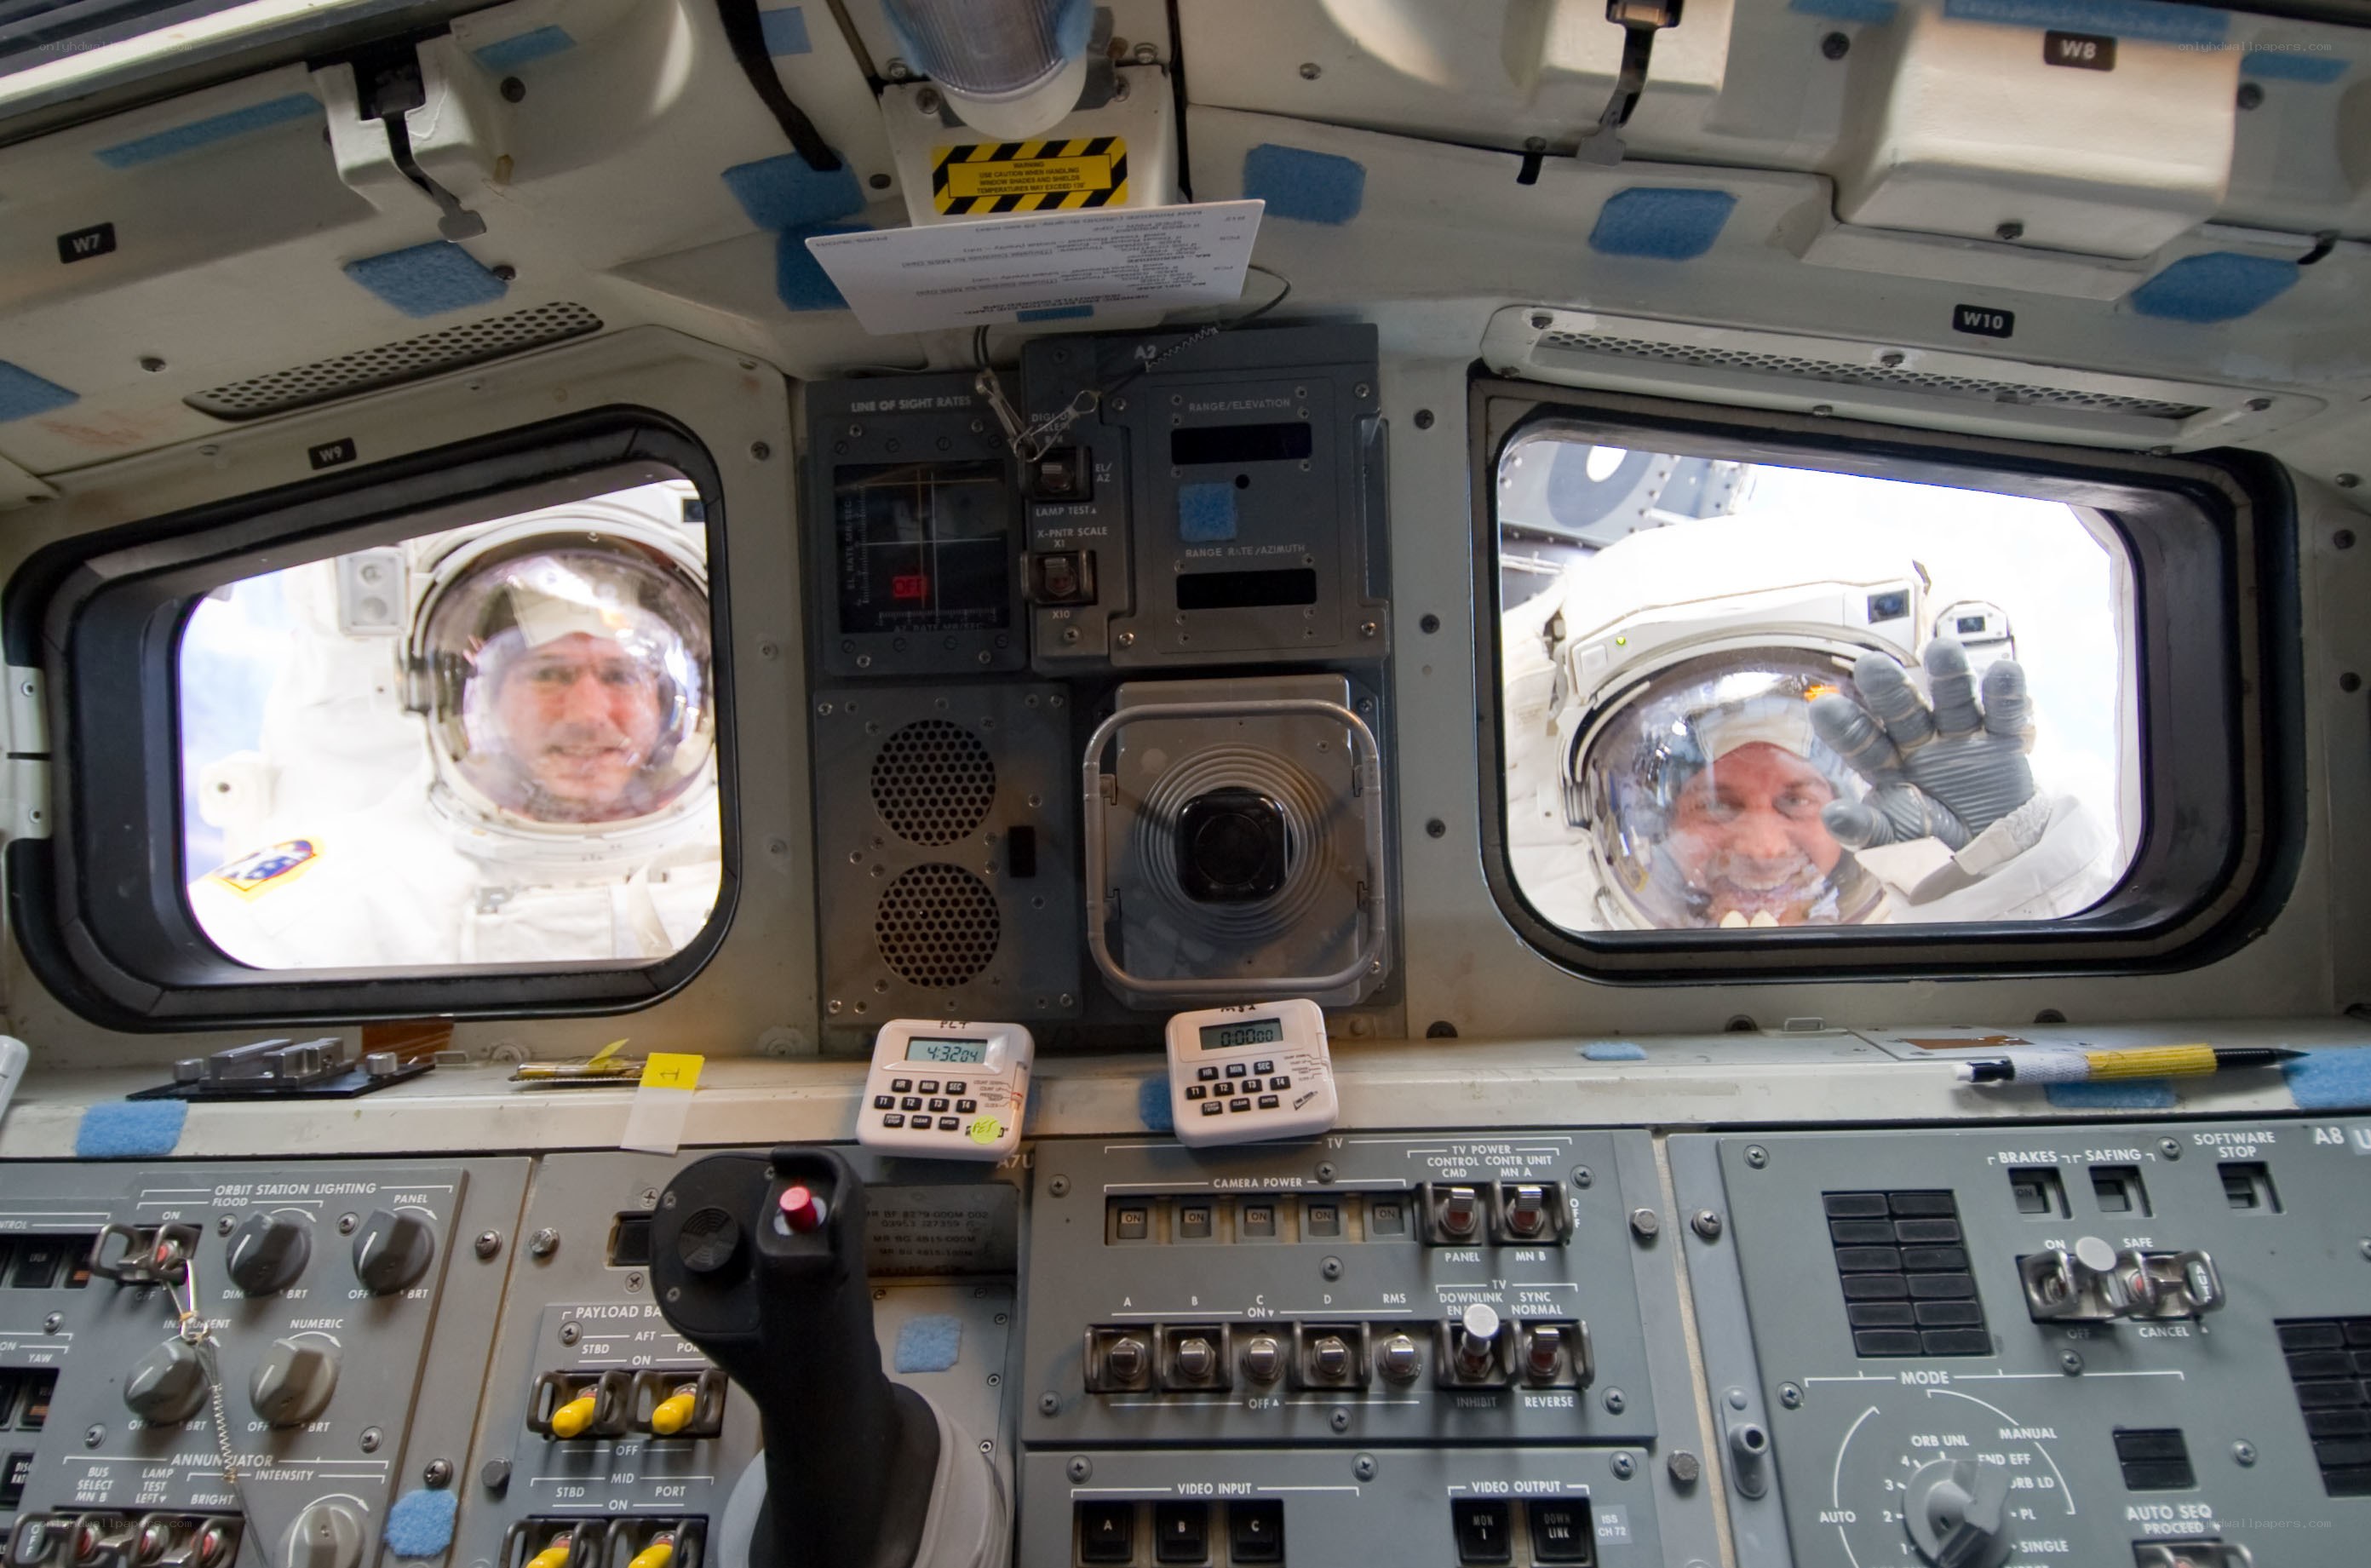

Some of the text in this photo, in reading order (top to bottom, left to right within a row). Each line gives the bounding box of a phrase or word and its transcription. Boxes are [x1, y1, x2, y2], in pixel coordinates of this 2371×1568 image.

[2061, 39, 2097, 60] W8
[977, 186, 1029, 194] TEMPERATURES
[72, 233, 100, 253] W7
[1963, 311, 2004, 330] W10
[1134, 344, 1157, 359] A2
[851, 395, 972, 413] LINE OF SIGHT RATES
[1188, 399, 1291, 412] RANGE/ELEVATION
[319, 445, 343, 462] W9
[1097, 474, 1111, 482] AZ
[1036, 506, 1090, 517] LAMP TEST
[1037, 526, 1108, 538] X-PNTR SCALE
[1053, 539, 1065, 548] X1
[1185, 548, 1223, 558] RANGE
[1052, 610, 1071, 619] X10
[1229, 1065, 1243, 1073] MIN
[1257, 1061, 1271, 1071] SEC
[1203, 1068, 1213, 1077] HR
[921, 1082, 935, 1090] MIN
[949, 1083, 962, 1091] SEC
[1248, 1081, 1256, 1089] T3
[1275, 1077, 1285, 1086] T4
[1191, 1087, 1200, 1095] T1
[1220, 1083, 1229, 1092] T2
[906, 1098, 916, 1106] T2
[962, 1100, 970, 1109] T4
[2193, 1131, 2276, 1146] SOFTWARE
[2315, 1127, 2345, 1145] A8
[1328, 1138, 1343, 1148] TV
[1452, 1145, 1512, 1155] TV POWER
[2086, 1149, 2142, 1162] SAFING
[2219, 1146, 2257, 1158] STOP
[1427, 1156, 1480, 1167] CONTROL
[1484, 1155, 1553, 1166] CONTR UNIT
[1999, 1151, 2058, 1164] BRAKES
[1442, 1168, 1467, 1178] CMD
[1501, 1168, 1532, 1177] MN A
[1214, 1177, 1303, 1189] CAMERA POWER
[214, 1183, 377, 1196] ORBIT STATION LIGHTING
[211, 1198, 248, 1207] FLOOD
[393, 1194, 428, 1203] PANEL
[162, 1211, 181, 1221] ON
[1125, 1214, 1141, 1223] ON
[1188, 1213, 1204, 1222] ON
[1251, 1212, 1267, 1221] ON
[1315, 1211, 1331, 1220] ON
[1379, 1209, 1395, 1219] ON
[2044, 1239, 2067, 1250] ON
[2122, 1238, 2154, 1249] SAFE
[1444, 1252, 1481, 1262] PANEL
[1516, 1251, 1547, 1261] MN B
[1492, 1280, 1507, 1289] TV
[222, 1289, 244, 1299] DIM
[286, 1289, 308, 1299] BRT
[406, 1289, 429, 1299] BRT
[1383, 1294, 1406, 1304] RMS
[1439, 1292, 1503, 1303] DOWNLINK
[1519, 1292, 1551, 1302] SYNC
[1123, 1296, 1132, 1307] A
[1191, 1296, 1198, 1306] B
[1256, 1295, 1264, 1305] C
[1323, 1295, 1332, 1305] D
[576, 1306, 639, 1318] PAYLOAD
[1248, 1307, 1266, 1318] ON
[1511, 1305, 1563, 1316] NORMAL
[290, 1318, 344, 1329] NUMERIC
[634, 1331, 656, 1341] AFT
[2138, 1326, 2190, 1338] CANCEL
[582, 1344, 610, 1354] STBD
[28, 1353, 53, 1363] YAW
[632, 1355, 652, 1365] ON
[1900, 1370, 1951, 1386] MODE
[1249, 1398, 1270, 1409] OFF
[1456, 1397, 1497, 1408] INHIBIT
[1524, 1397, 1574, 1408] REVERSE
[186, 1422, 208, 1431] BRT
[307, 1422, 330, 1432] BRT
[1999, 1427, 2058, 1439] MANUAL
[1911, 1435, 1970, 1447] ORB UNL
[615, 1445, 639, 1456] OFF
[1901, 1455, 1910, 1467] 4
[2010, 1453, 2031, 1465] EFF
[88, 1467, 110, 1478] BUS
[141, 1468, 175, 1479] LAMP
[255, 1470, 315, 1481] INTENSITY
[611, 1473, 634, 1484] MID
[2037, 1477, 2054, 1489] LD
[77, 1479, 113, 1490] SELECT
[142, 1481, 167, 1492] TEST
[1177, 1483, 1252, 1495] VIDEO INPUT
[1472, 1481, 1561, 1493] VIDEO OUTPUT
[1885, 1479, 1894, 1491] 3
[555, 1487, 585, 1497] STBD
[655, 1485, 686, 1496] PORT
[75, 1491, 109, 1502] MN B
[135, 1493, 158, 1504] LEFT
[190, 1494, 235, 1506] BRIGHT
[608, 1500, 629, 1511] ON
[1819, 1511, 1857, 1524] AUTO
[1882, 1510, 1892, 1523] 2
[2019, 1508, 2037, 1520] PL
[2127, 1504, 2213, 1521] AUTO SEQ
[1473, 1515, 1493, 1526] MON
[1544, 1513, 1570, 1524] DOWN
[1600, 1514, 1619, 1525] ISS
[1103, 1519, 1112, 1531] A
[1178, 1520, 1186, 1532] B
[1251, 1520, 1260, 1532] C
[2143, 1522, 2205, 1535] PROCEED
[1548, 1527, 1570, 1539] LINK
[1598, 1527, 1627, 1537] CH 72
[1901, 1542, 1908, 1555] 1
[2021, 1540, 2070, 1553] SINGLE
